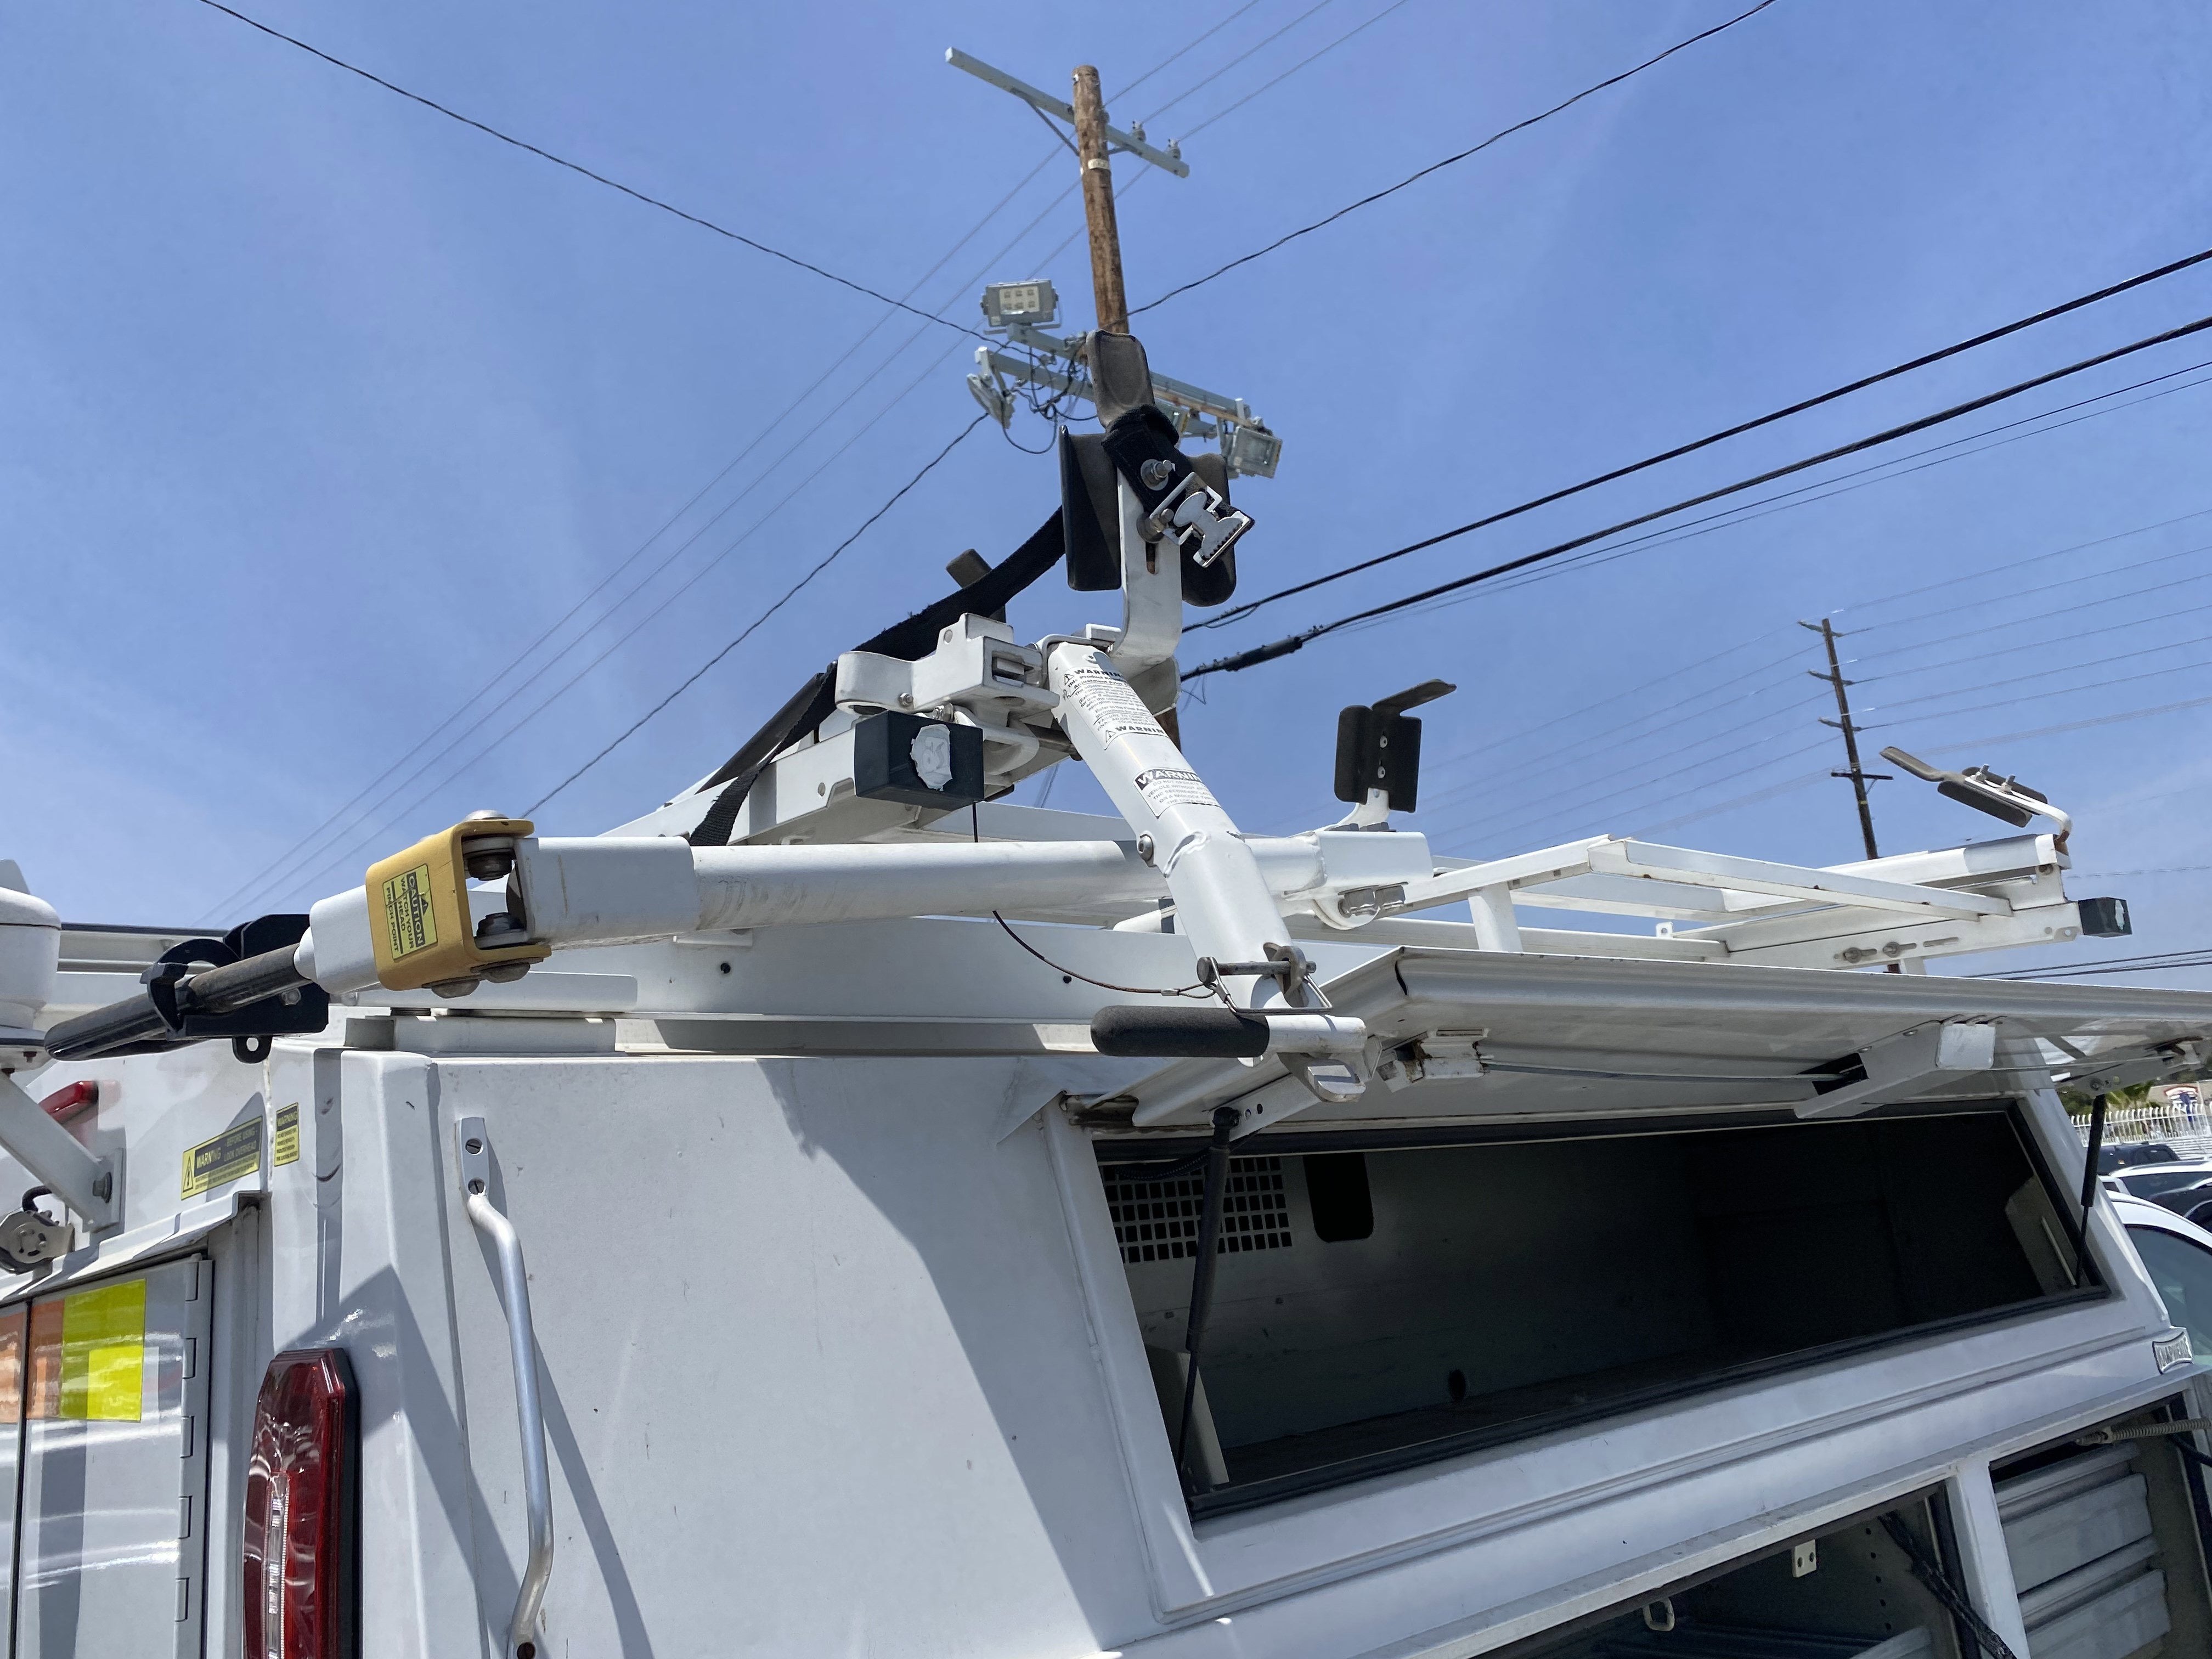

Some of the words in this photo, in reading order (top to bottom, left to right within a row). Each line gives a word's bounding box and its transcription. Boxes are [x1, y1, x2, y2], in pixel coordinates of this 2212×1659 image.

[1074, 669, 1123, 678] WARNIN
[1115, 725, 1164, 735] WARNIN
[1137, 770, 1201, 785] WARNIN
[1153, 792, 1164, 800] THE
[400, 877, 410, 917] WATCH
[408, 875, 424, 945] CAUTION
[391, 922, 399, 952] POINT
[196, 1147, 222, 1169] WARNING
